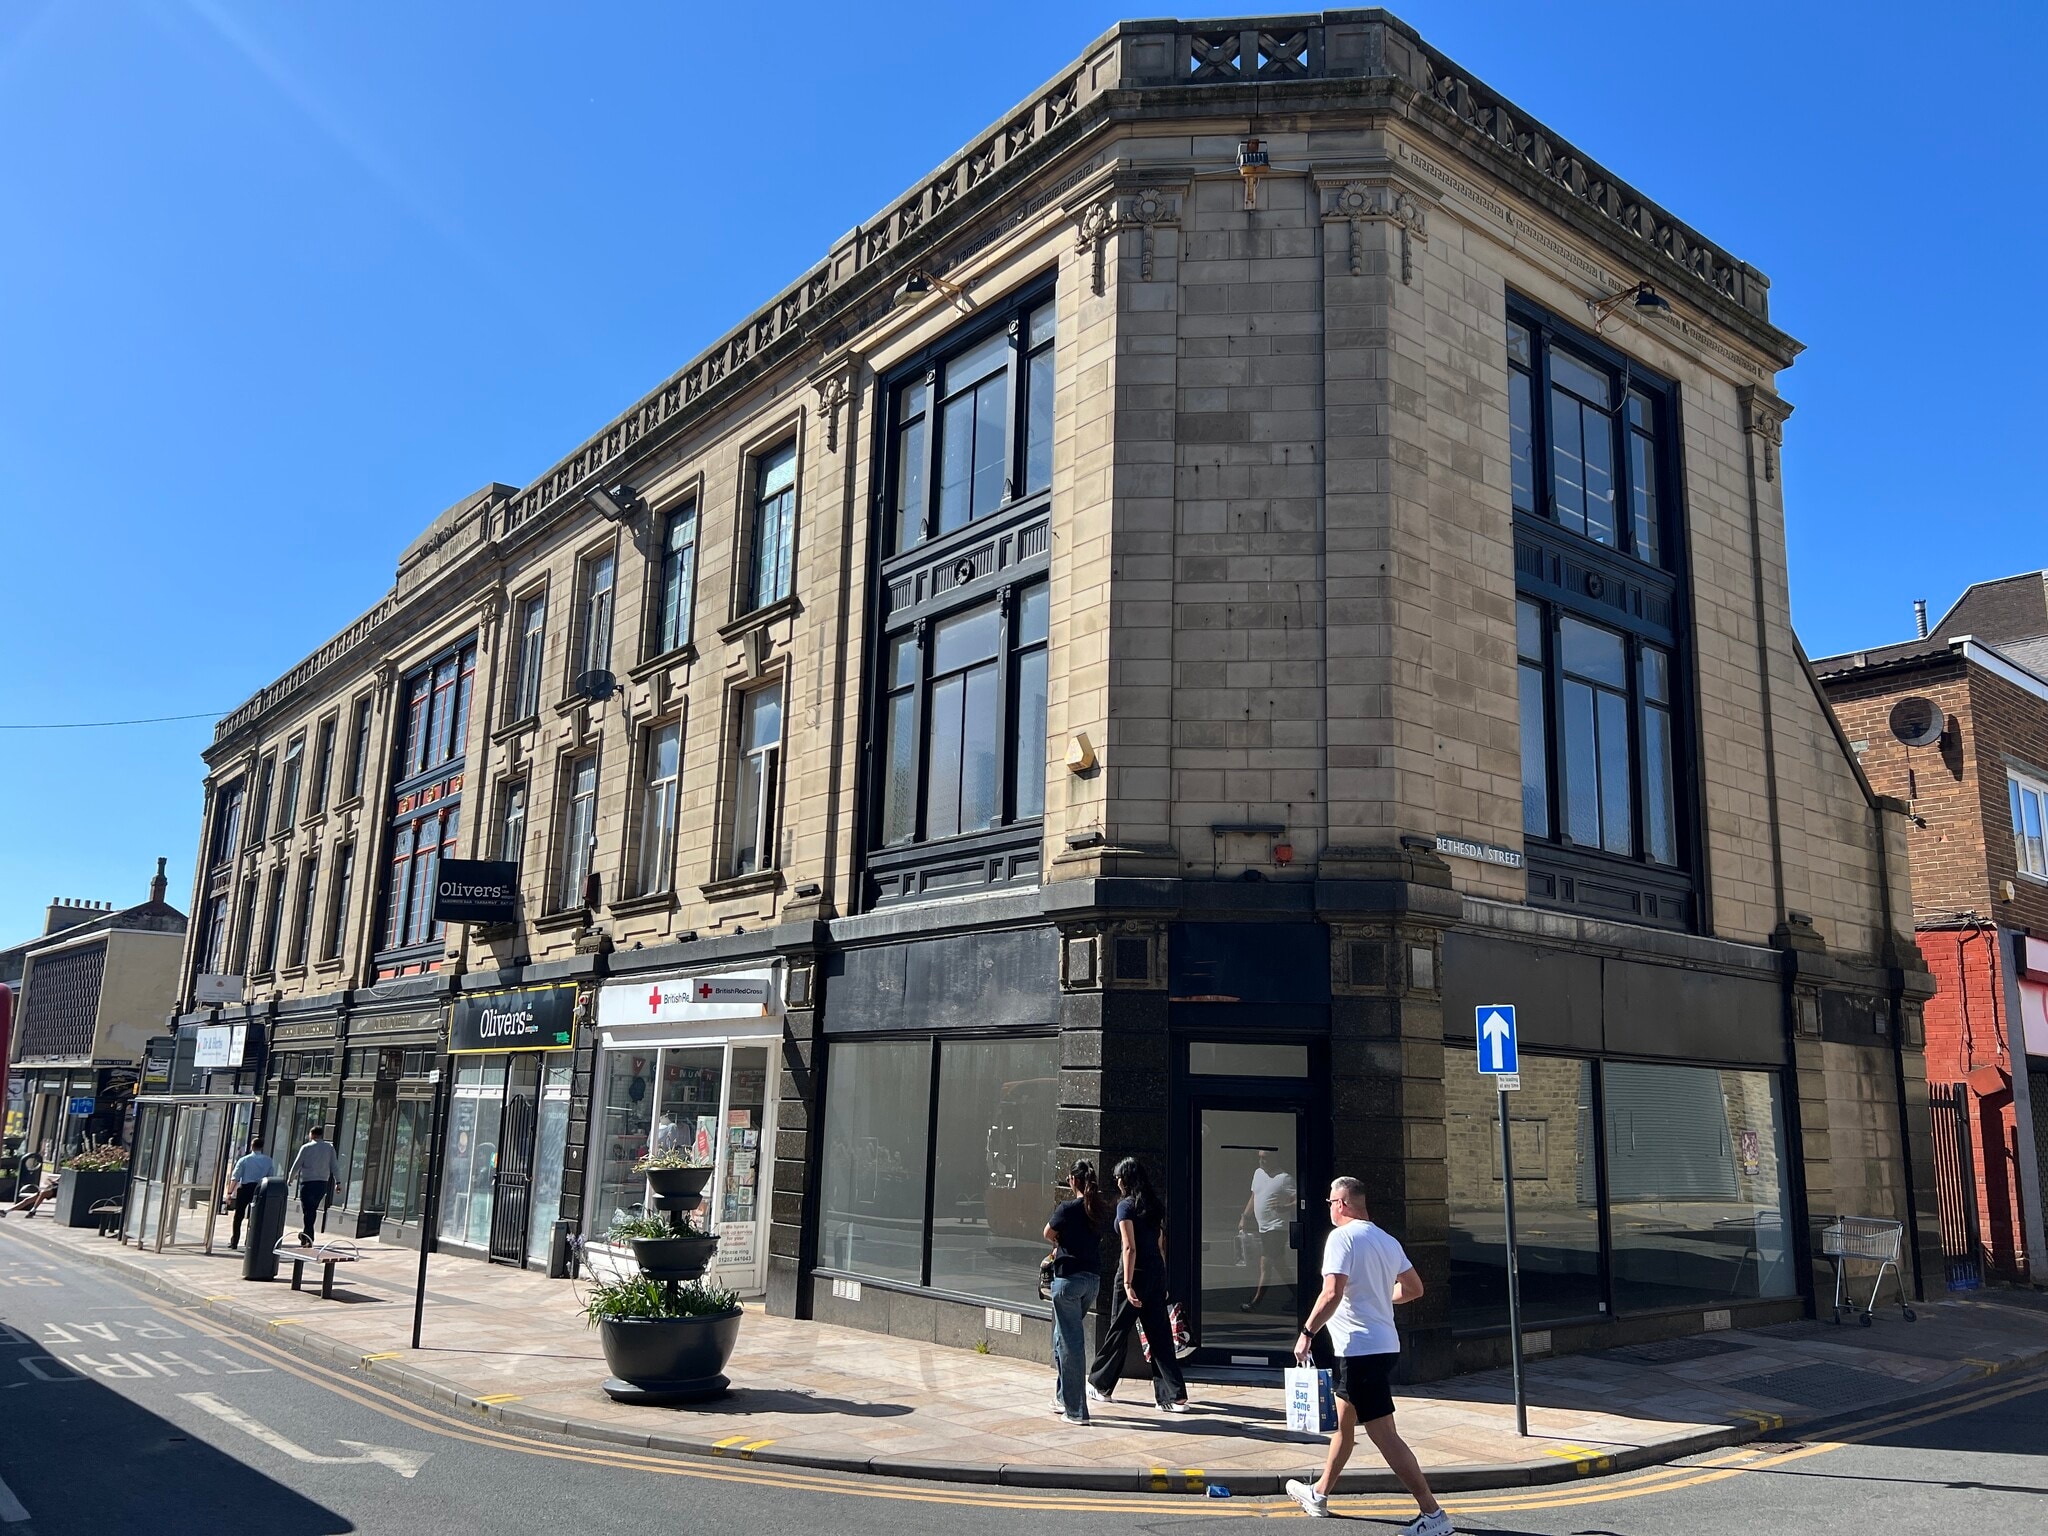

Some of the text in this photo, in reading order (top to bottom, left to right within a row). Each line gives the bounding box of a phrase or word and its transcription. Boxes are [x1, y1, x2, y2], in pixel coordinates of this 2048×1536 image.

[404, 527, 473, 591] EMPIRE BUILDINGS
[1436, 837, 1521, 866] BETHESDA STREET
[440, 881, 501, 898] Olivers
[480, 1008, 527, 1038] Olivers
[1295, 1390, 1308, 1402] Bag
[1293, 1401, 1311, 1412] some
[1297, 1410, 1307, 1423] joy
